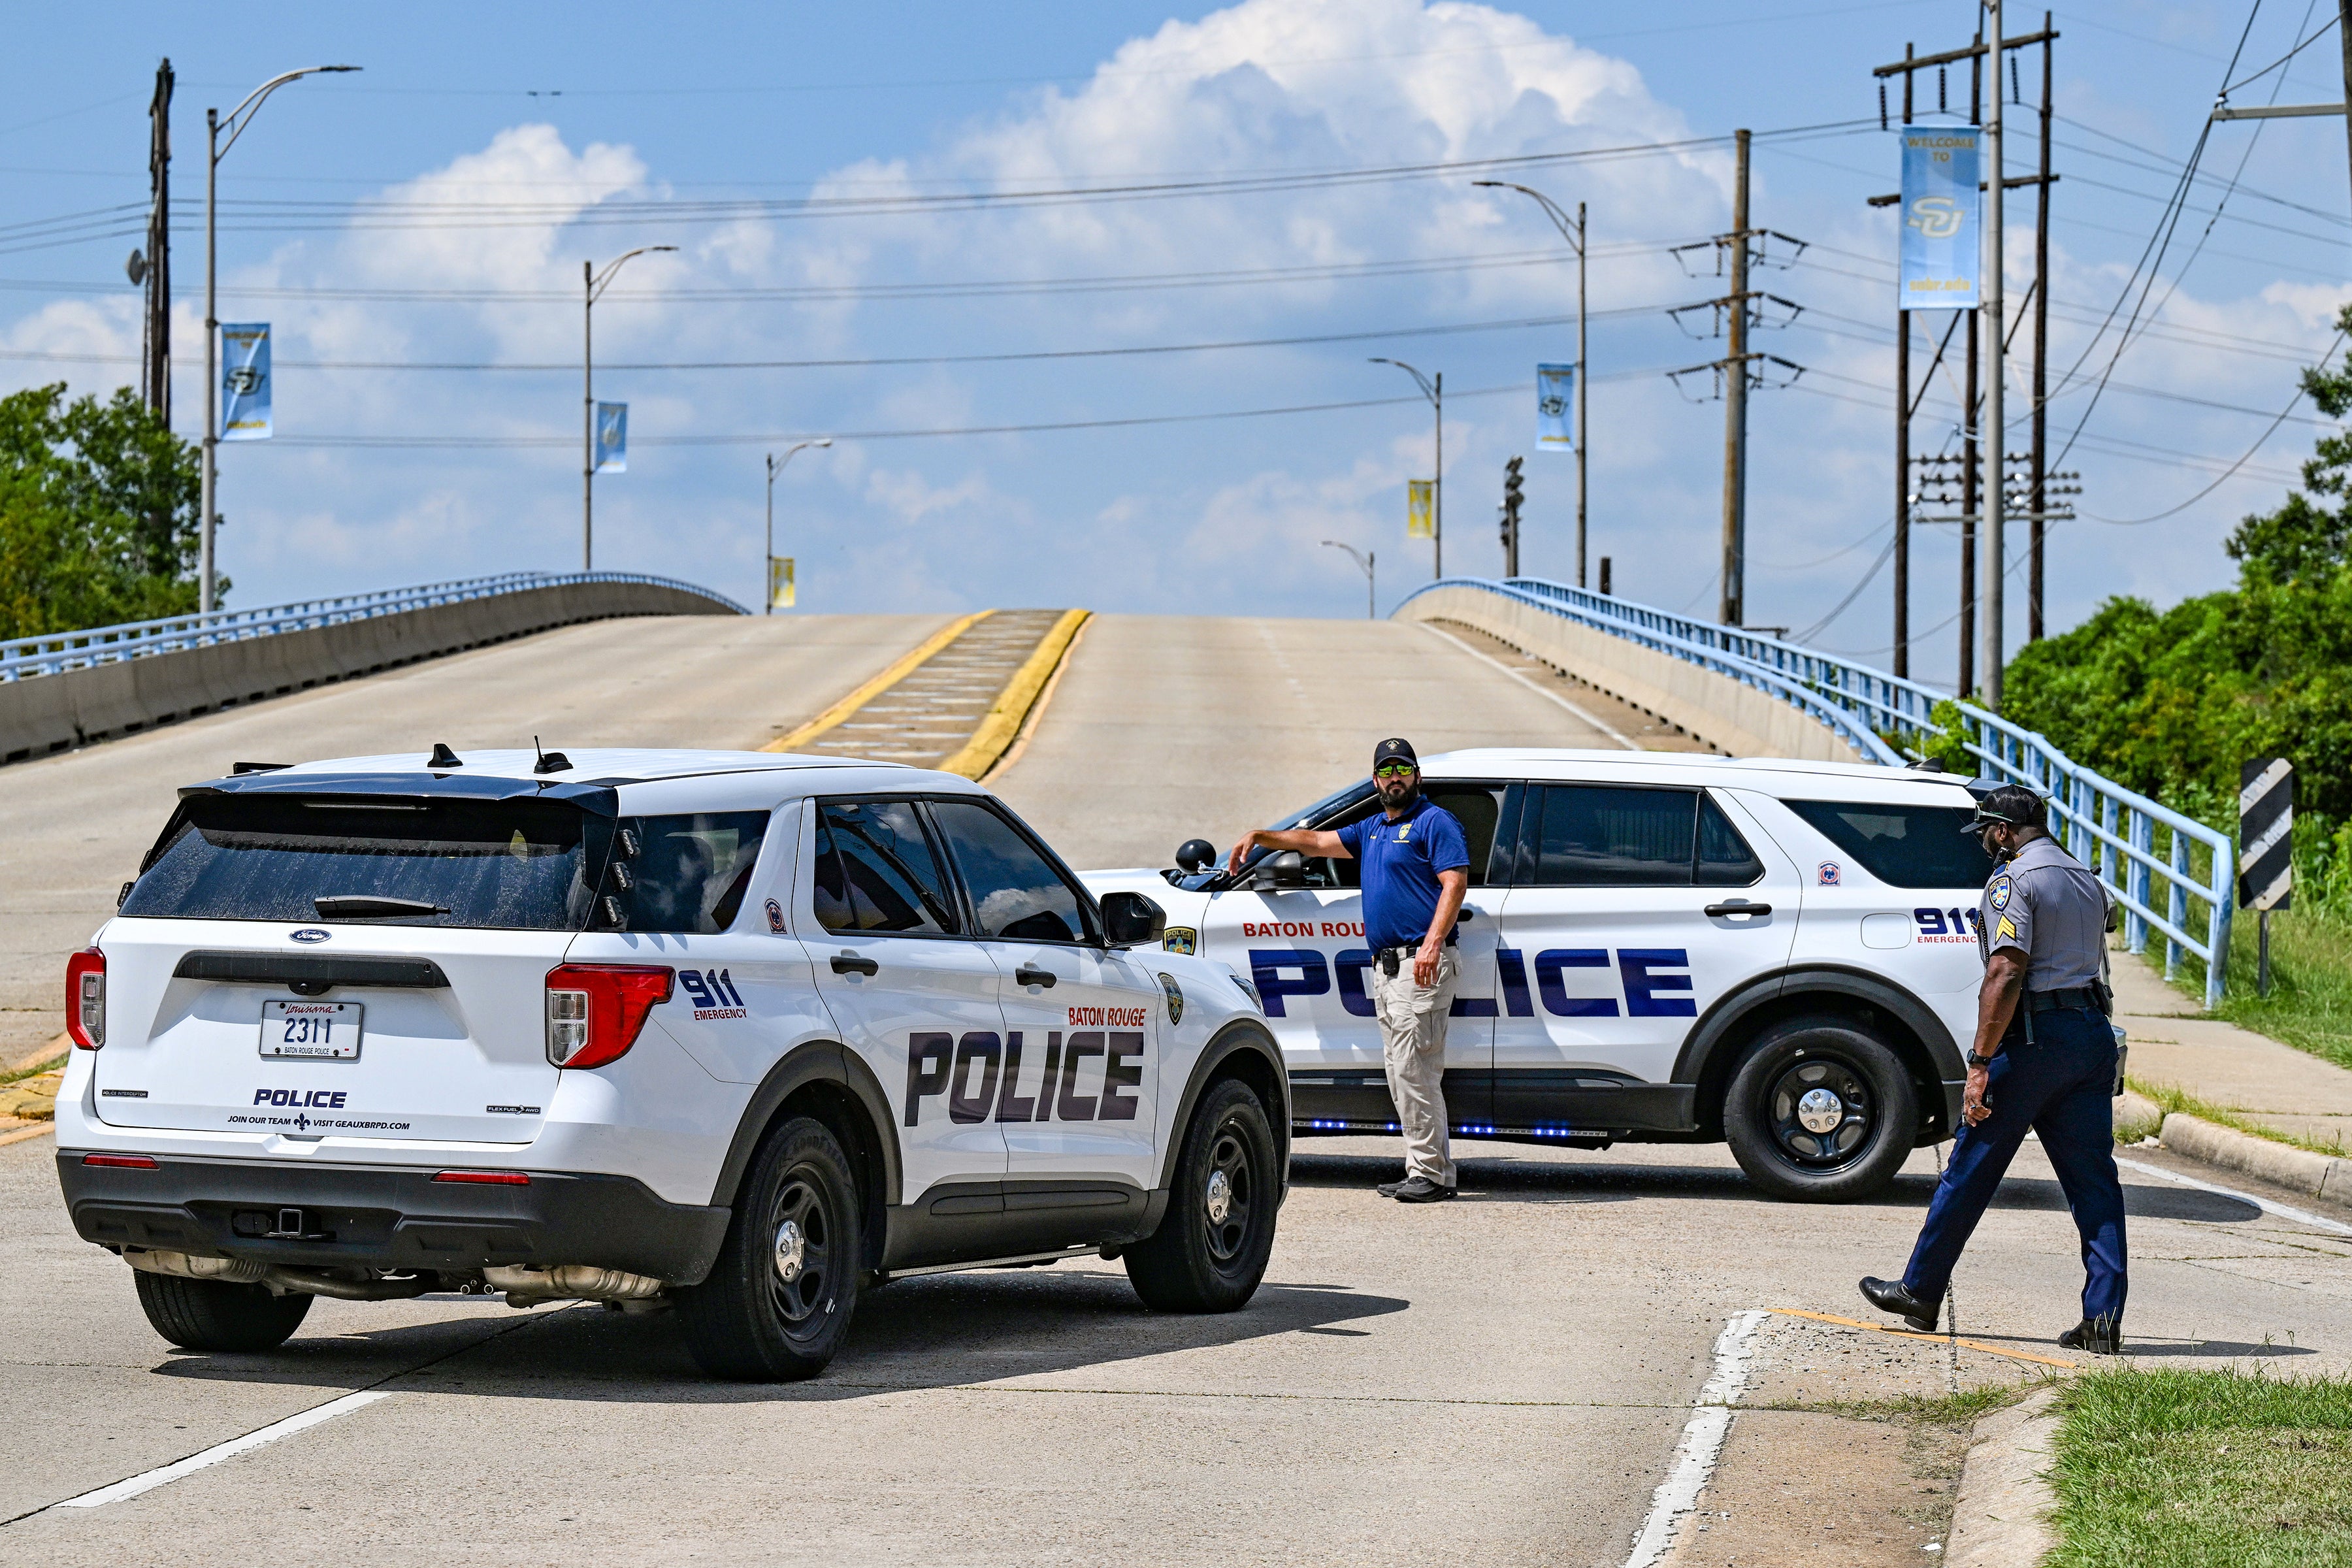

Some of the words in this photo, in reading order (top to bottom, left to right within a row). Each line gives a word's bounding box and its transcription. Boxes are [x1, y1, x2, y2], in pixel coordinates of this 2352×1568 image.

[1908, 137, 1974, 148] WELCOME
[1932, 151, 1950, 162] TO
[1907, 196, 1965, 239] SU
[1243, 923, 1314, 937] BATON
[678, 969, 744, 1008] 911
[285, 1004, 336, 1014] Louisiana
[694, 1009, 747, 1021] EMERGENCY
[1068, 1007, 1105, 1026] BATON
[1107, 1007, 1146, 1026] ROUGE
[284, 1017, 331, 1044] 2311
[904, 1032, 1144, 1127] POLICE
[253, 1088, 347, 1109] POLICE
[248, 1116, 266, 1124] OUR
[313, 1119, 335, 1128] VISIT
[335, 1120, 410, 1130] GEAUXBRPD.COM
